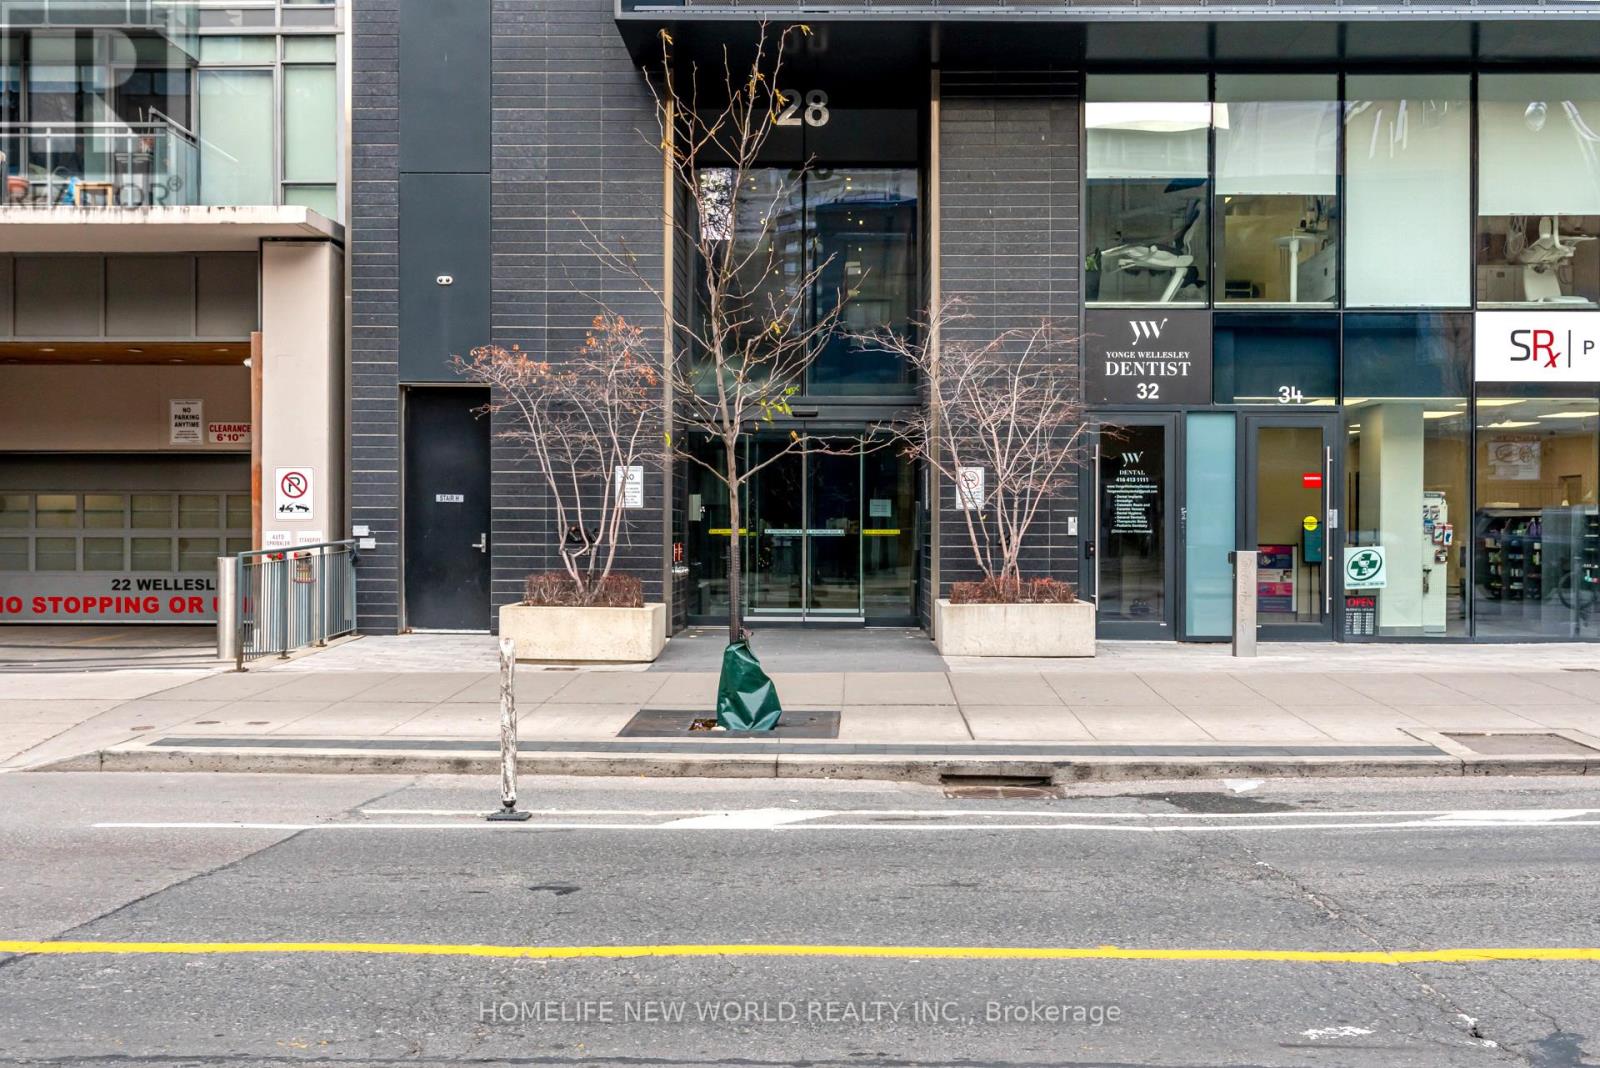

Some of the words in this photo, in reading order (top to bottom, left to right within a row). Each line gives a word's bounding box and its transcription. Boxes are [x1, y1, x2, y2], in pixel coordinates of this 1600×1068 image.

[777, 89, 830, 127] 28
[1106, 351, 1136, 359] YONGE
[1137, 351, 1190, 359] WELLESLEY
[1105, 361, 1191, 376] DENTIST
[1136, 382, 1160, 399] 32
[1278, 385, 1303, 404] 34
[209, 424, 252, 433] CLEARANCE
[111, 578, 131, 591] 22
[137, 579, 218, 591] WELLESL
[32, 596, 160, 614] STOPPING
[169, 596, 204, 614] OR
[1346, 597, 1375, 608] OPEN
